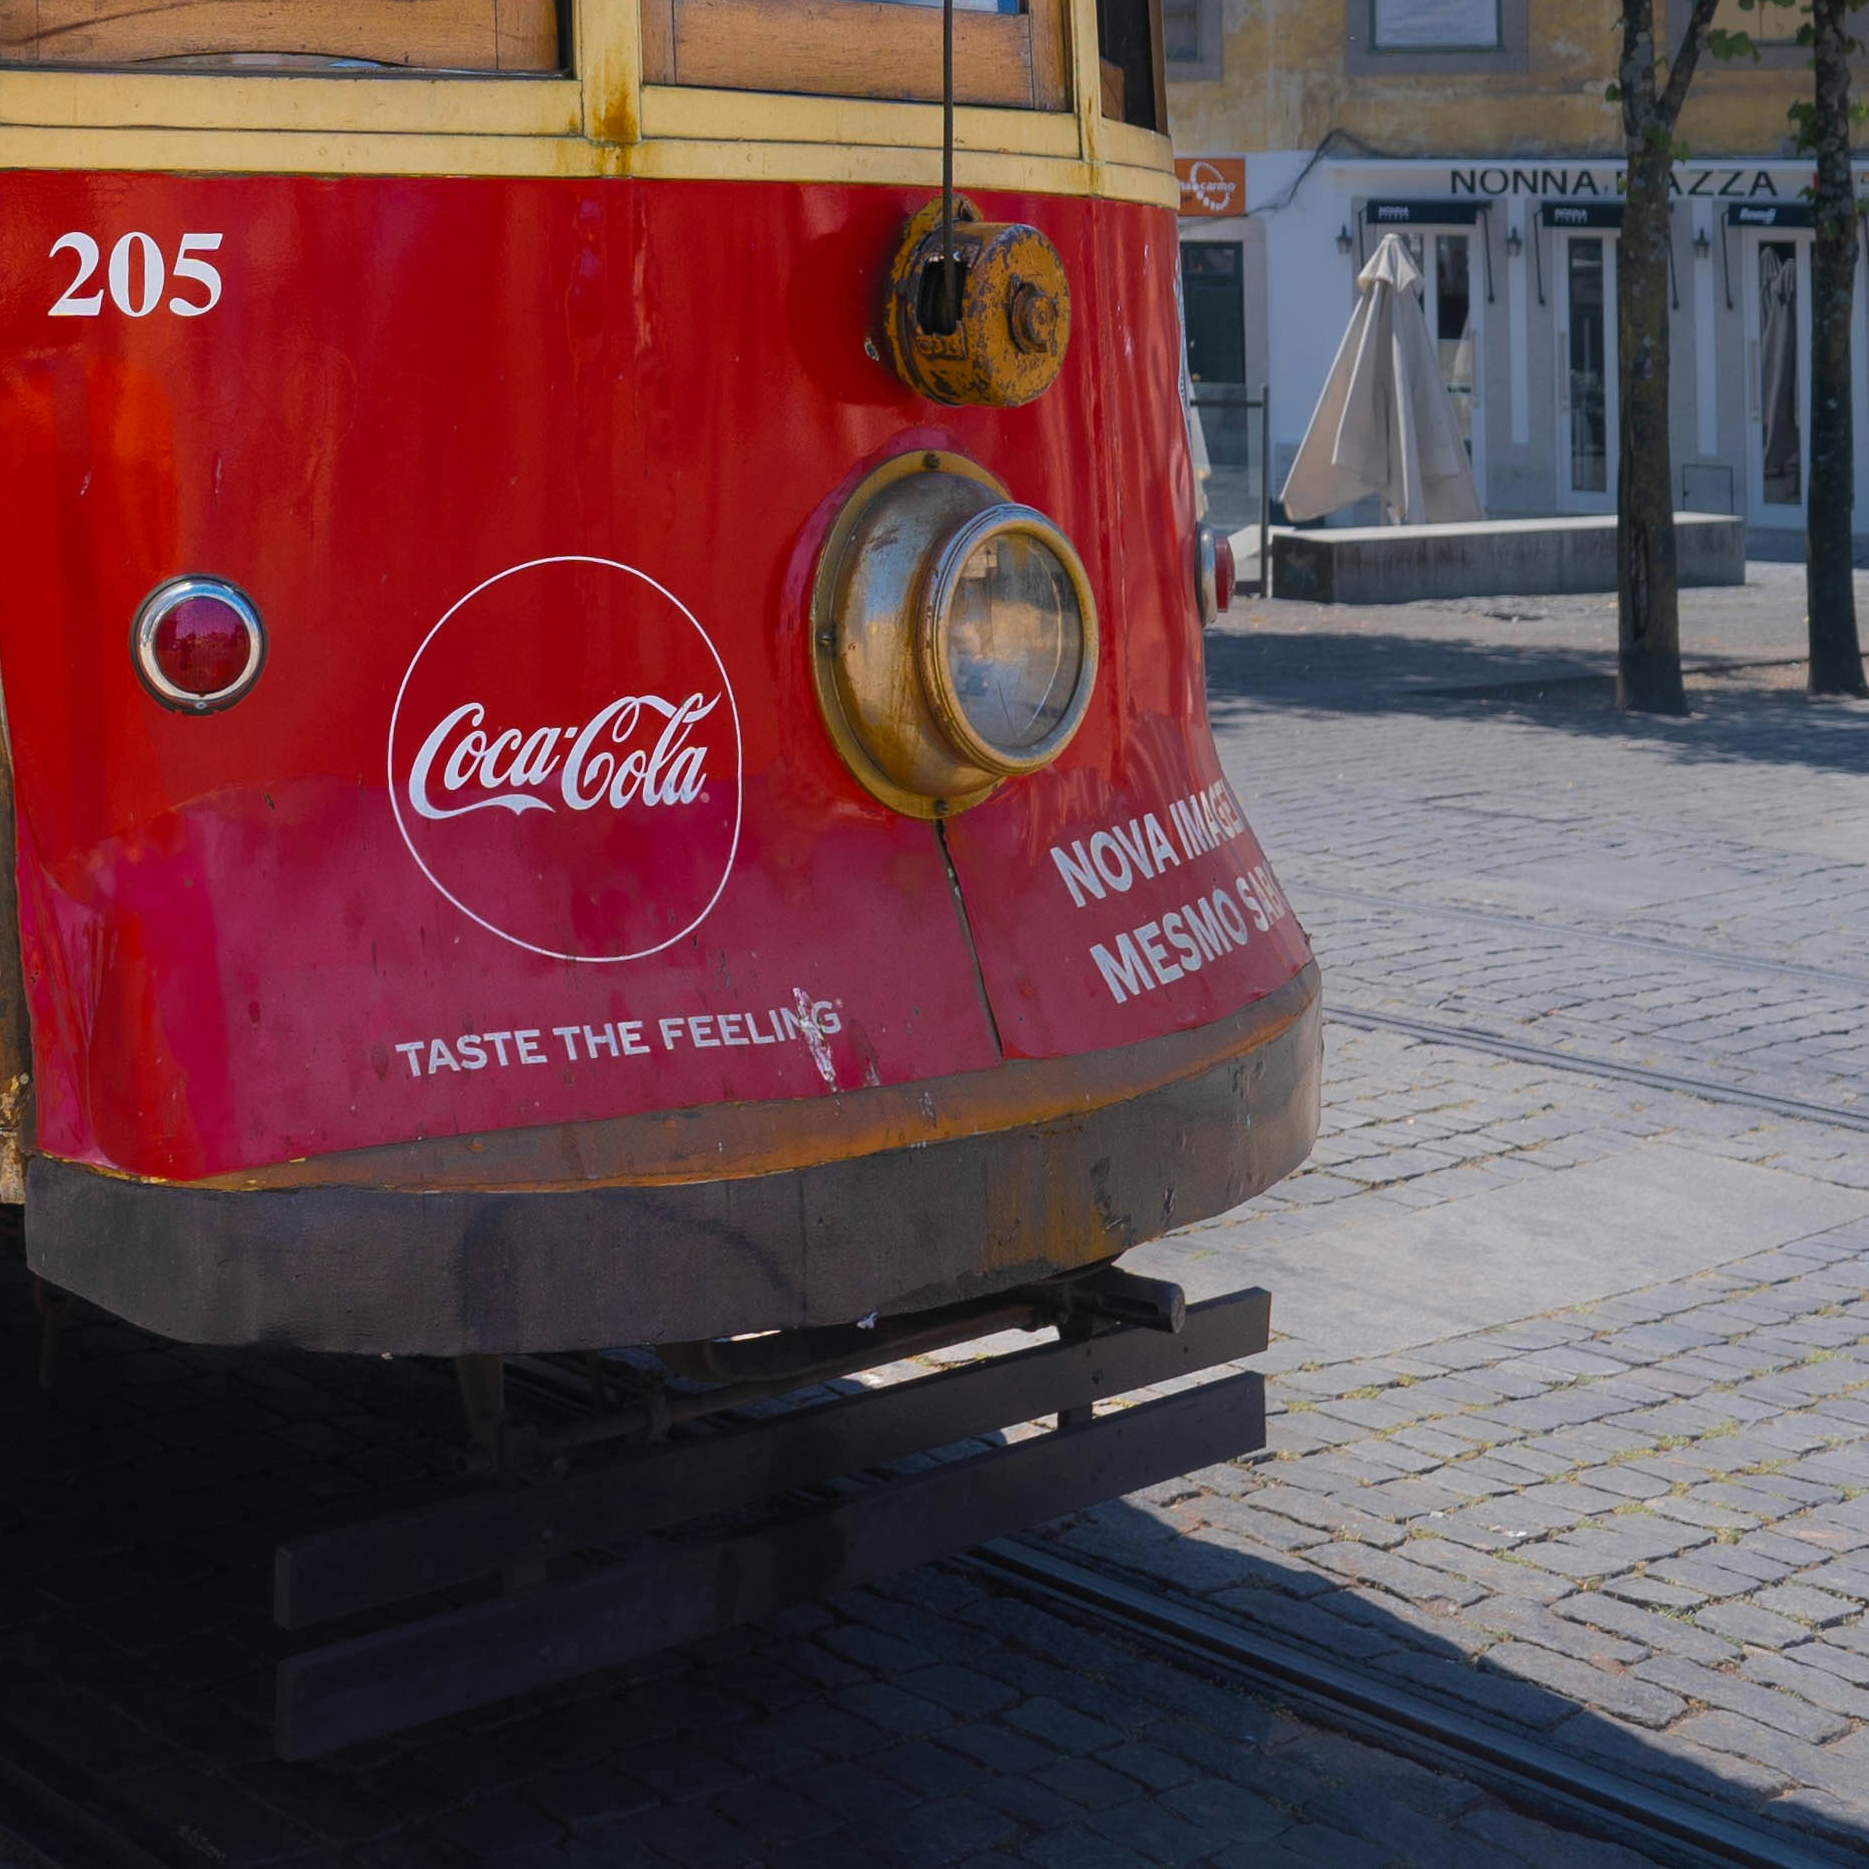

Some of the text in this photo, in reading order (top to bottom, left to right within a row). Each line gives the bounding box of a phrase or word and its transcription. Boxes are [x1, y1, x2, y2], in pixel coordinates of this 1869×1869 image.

[1450, 168, 1600, 196] NONNA
[47, 231, 224, 318] 205
[408, 690, 722, 820] Coca-Cola
[1049, 812, 1182, 909] NOVA
[1089, 888, 1249, 1005] MESMO
[394, 1000, 843, 1077] TASTE THE FEELING
